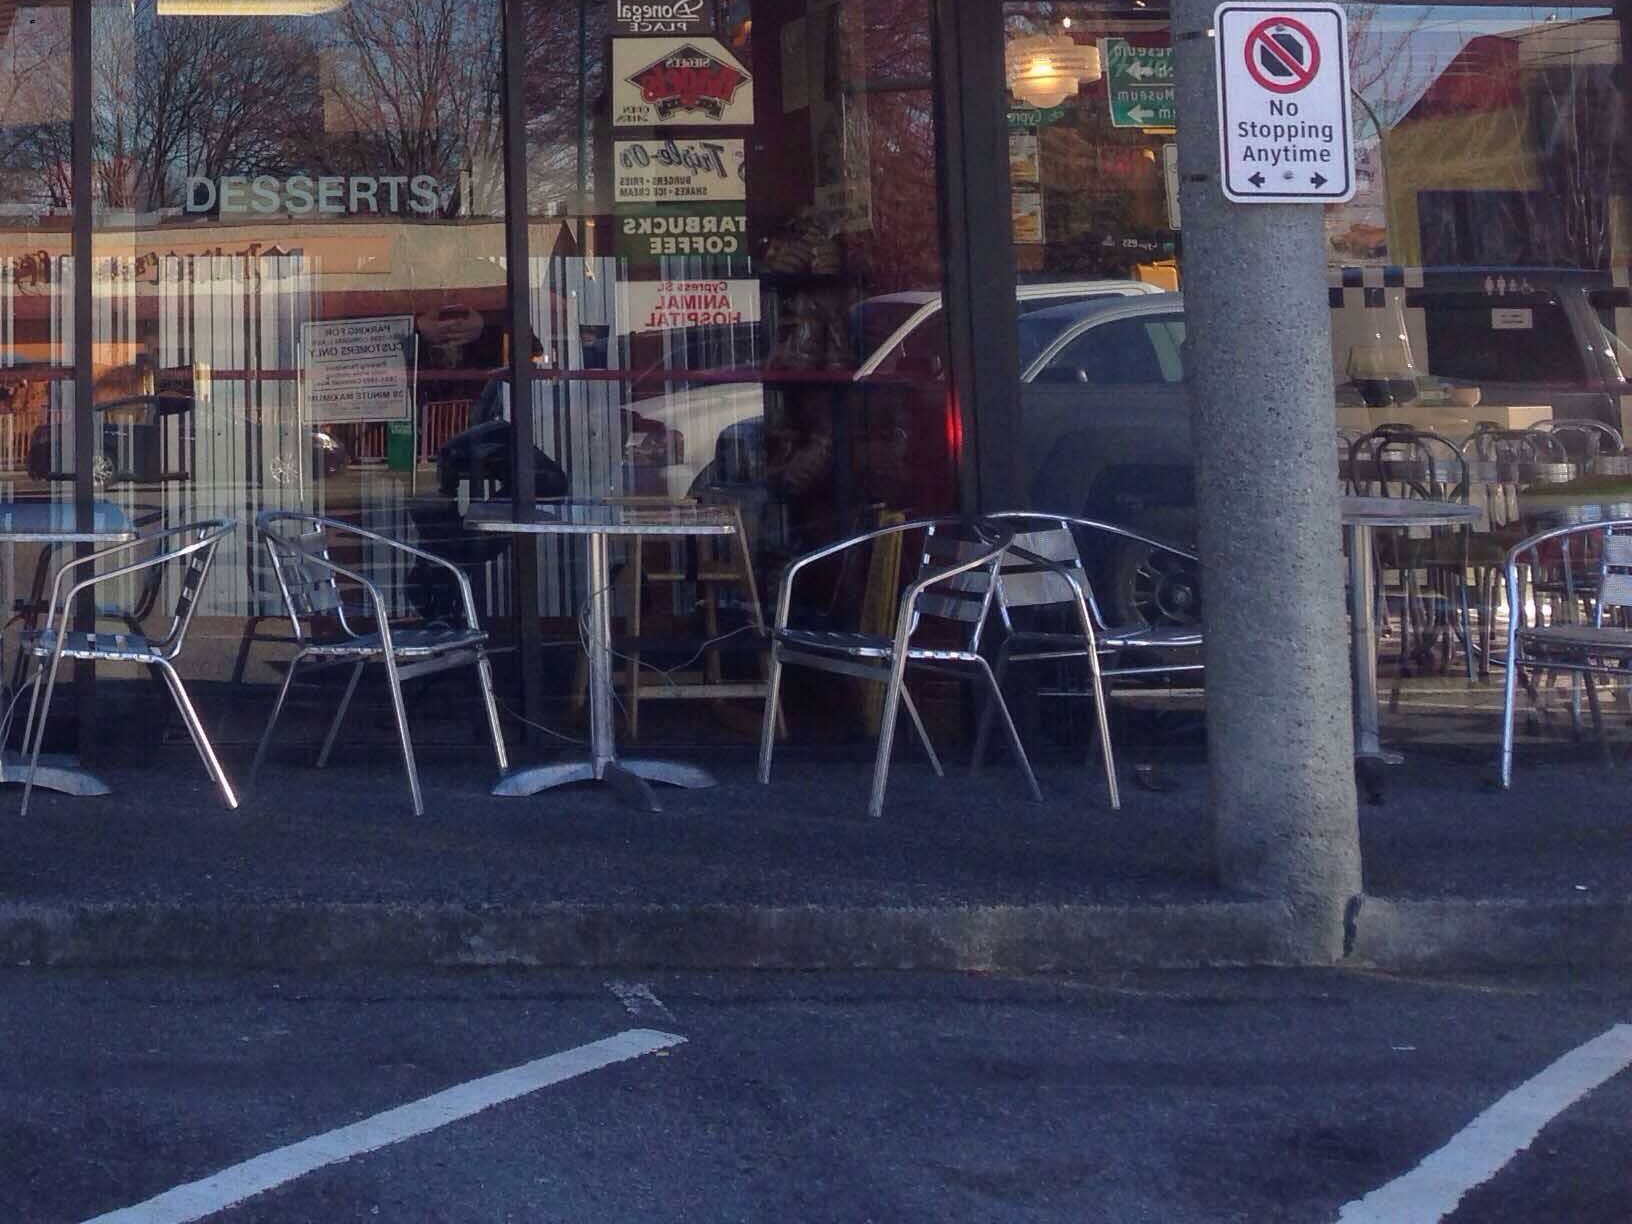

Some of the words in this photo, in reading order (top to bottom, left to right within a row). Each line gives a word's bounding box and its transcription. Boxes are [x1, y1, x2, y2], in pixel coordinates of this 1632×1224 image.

[1269, 99, 1299, 116] No
[1237, 121, 1334, 143] Stopping
[1242, 145, 1331, 166] Anytime
[185, 175, 441, 213] DESSERTS
